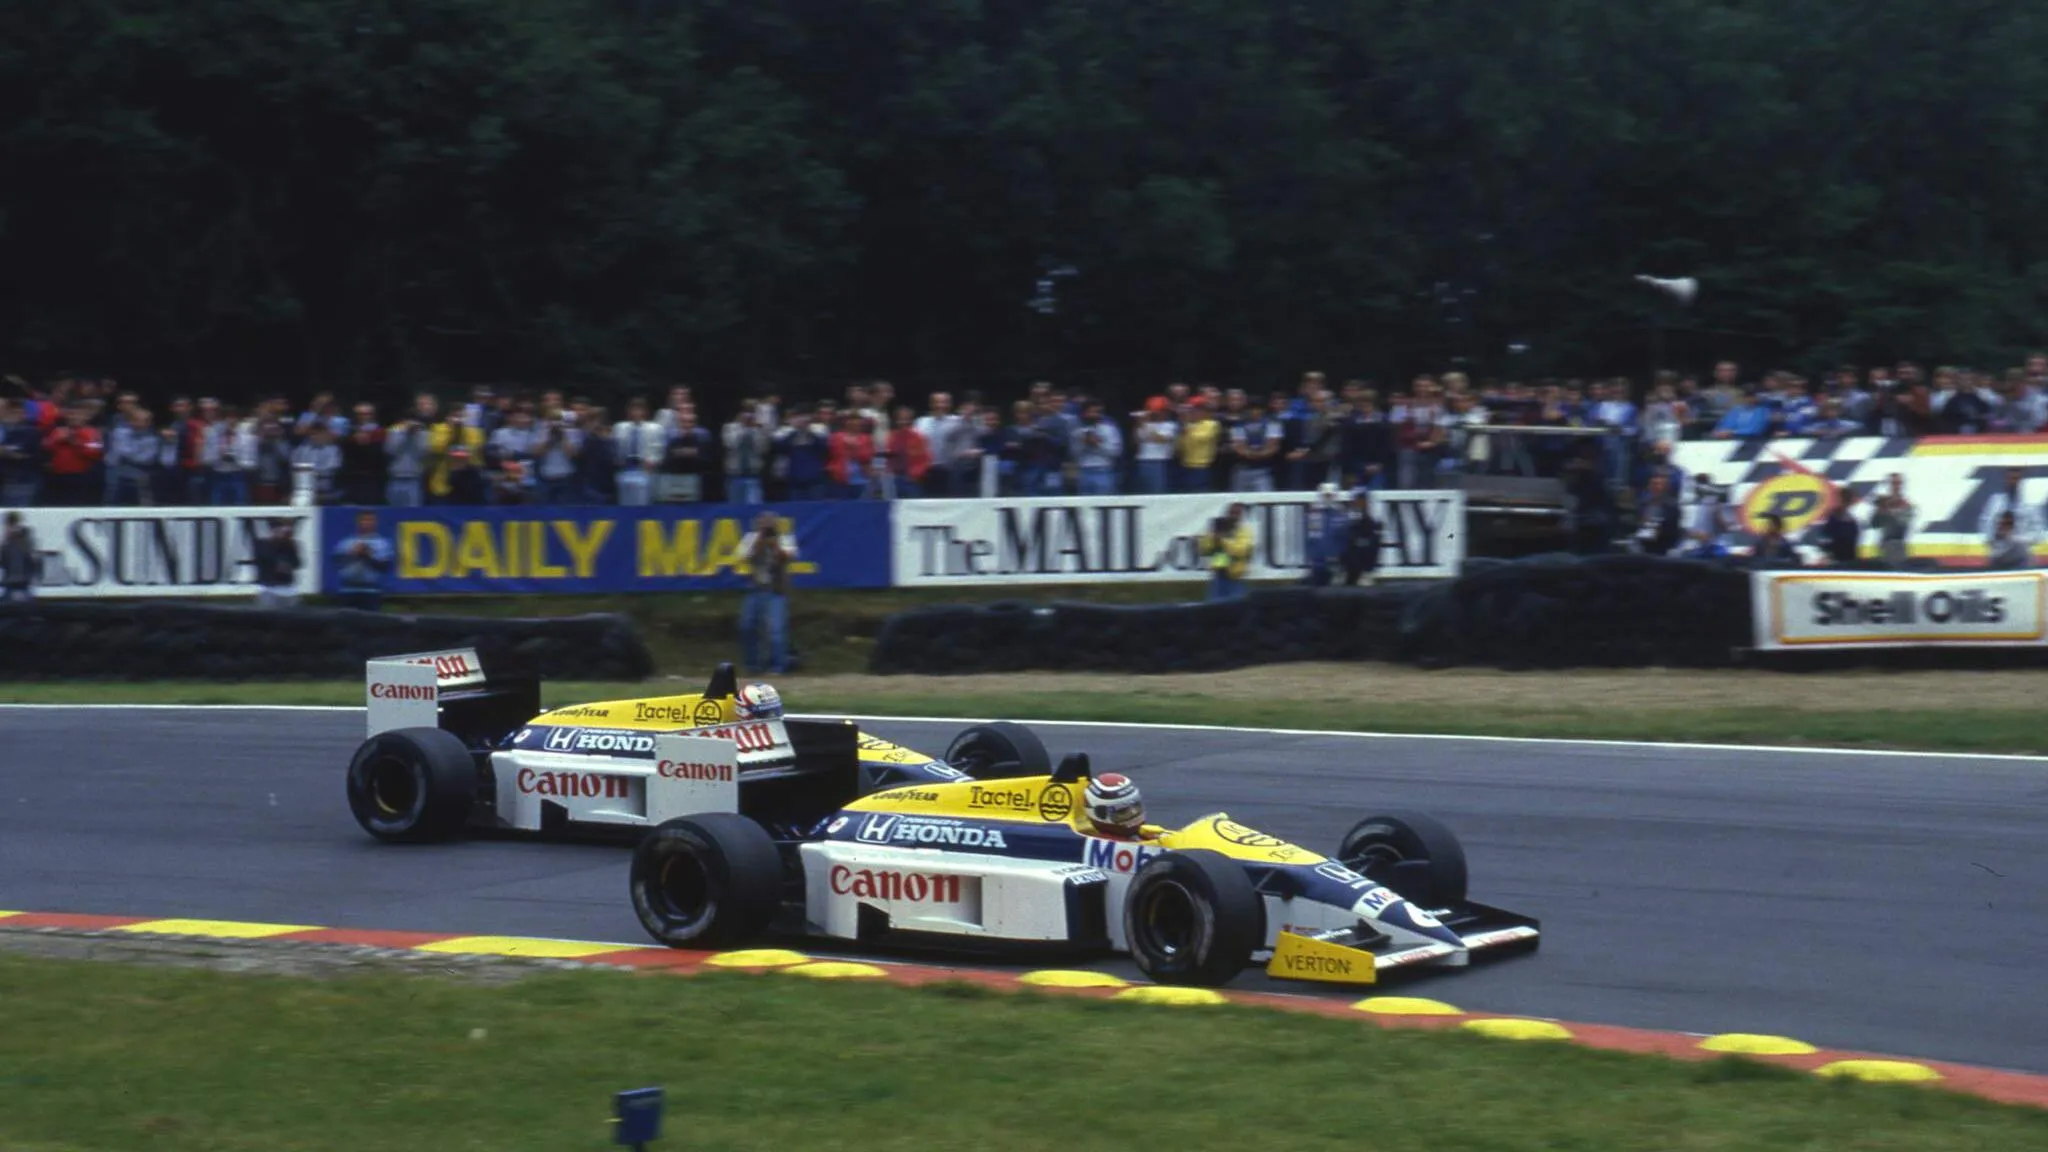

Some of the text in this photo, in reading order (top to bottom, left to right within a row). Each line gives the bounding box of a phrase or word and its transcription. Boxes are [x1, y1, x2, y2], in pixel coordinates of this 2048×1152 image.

[70, 516, 308, 585] SUNDA
[402, 519, 613, 579] DAILY
[910, 525, 990, 575] The
[996, 505, 1158, 573] MAIL
[1811, 590, 2008, 625] Shell Oils
[370, 682, 436, 700] Canon
[576, 735, 656, 752] HOND
[517, 768, 629, 798] Canon
[658, 760, 733, 781] Canon
[894, 824, 1007, 848] HONDA
[830, 865, 960, 902] Canon
